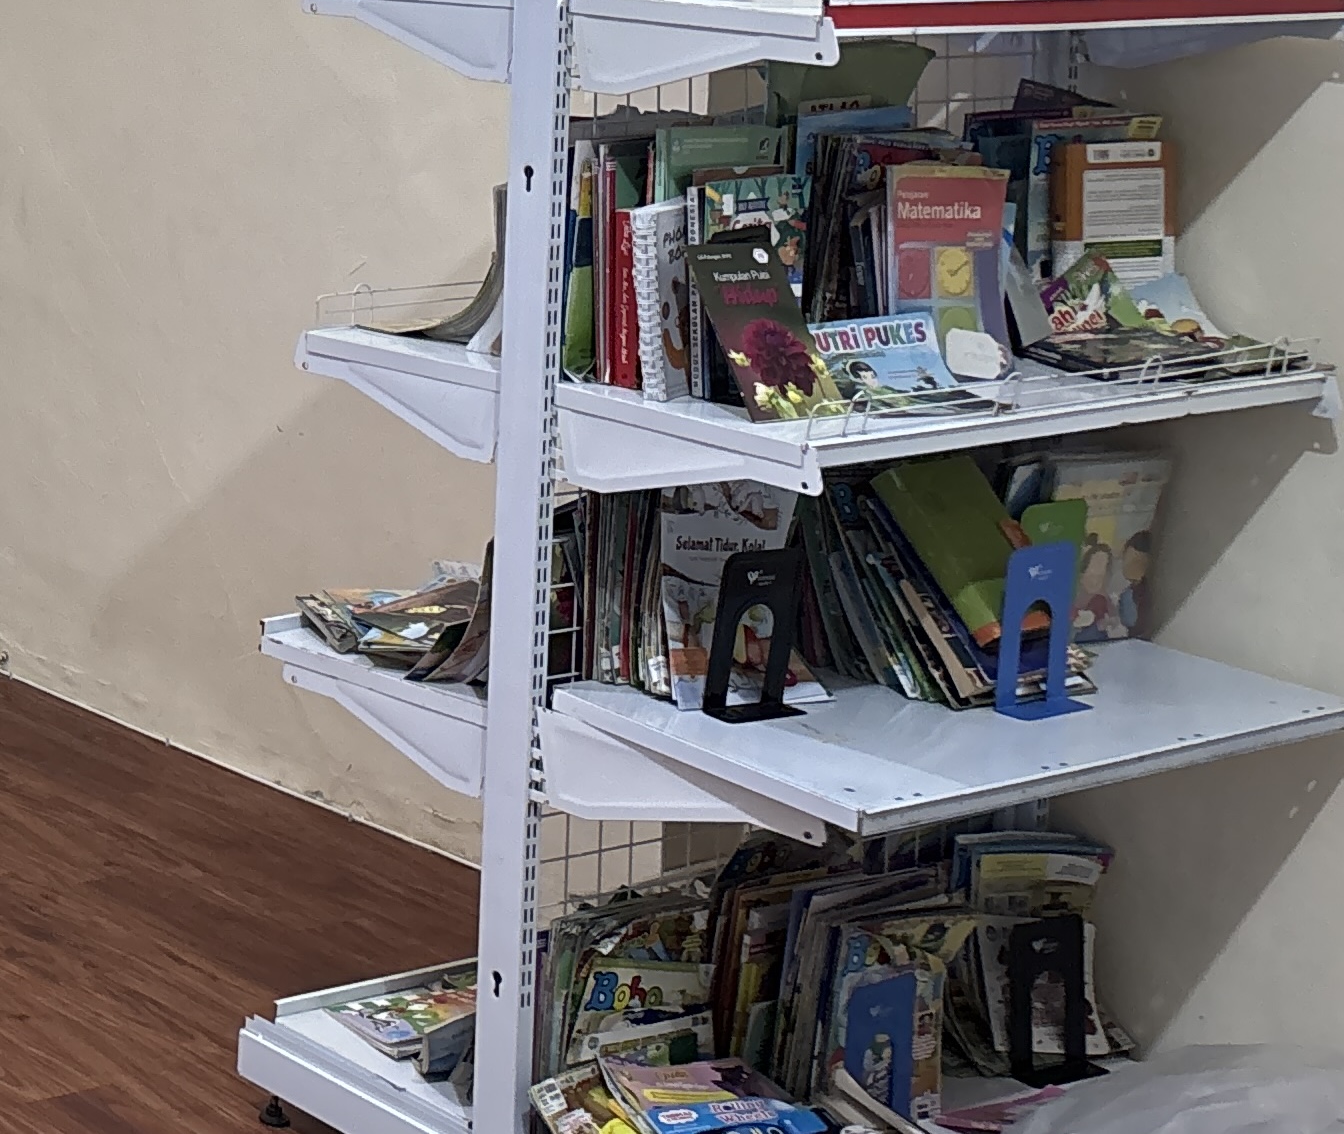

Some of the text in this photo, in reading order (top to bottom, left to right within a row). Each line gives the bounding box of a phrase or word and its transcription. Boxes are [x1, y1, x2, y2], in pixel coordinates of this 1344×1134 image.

[897, 201, 982, 220] Matematika
[713, 270, 750, 283] Kumpulan
[815, 321, 927, 353] UTRi PUKES
[675, 535, 713, 551] Selamat
[719, 1110, 777, 1123] Wheels
